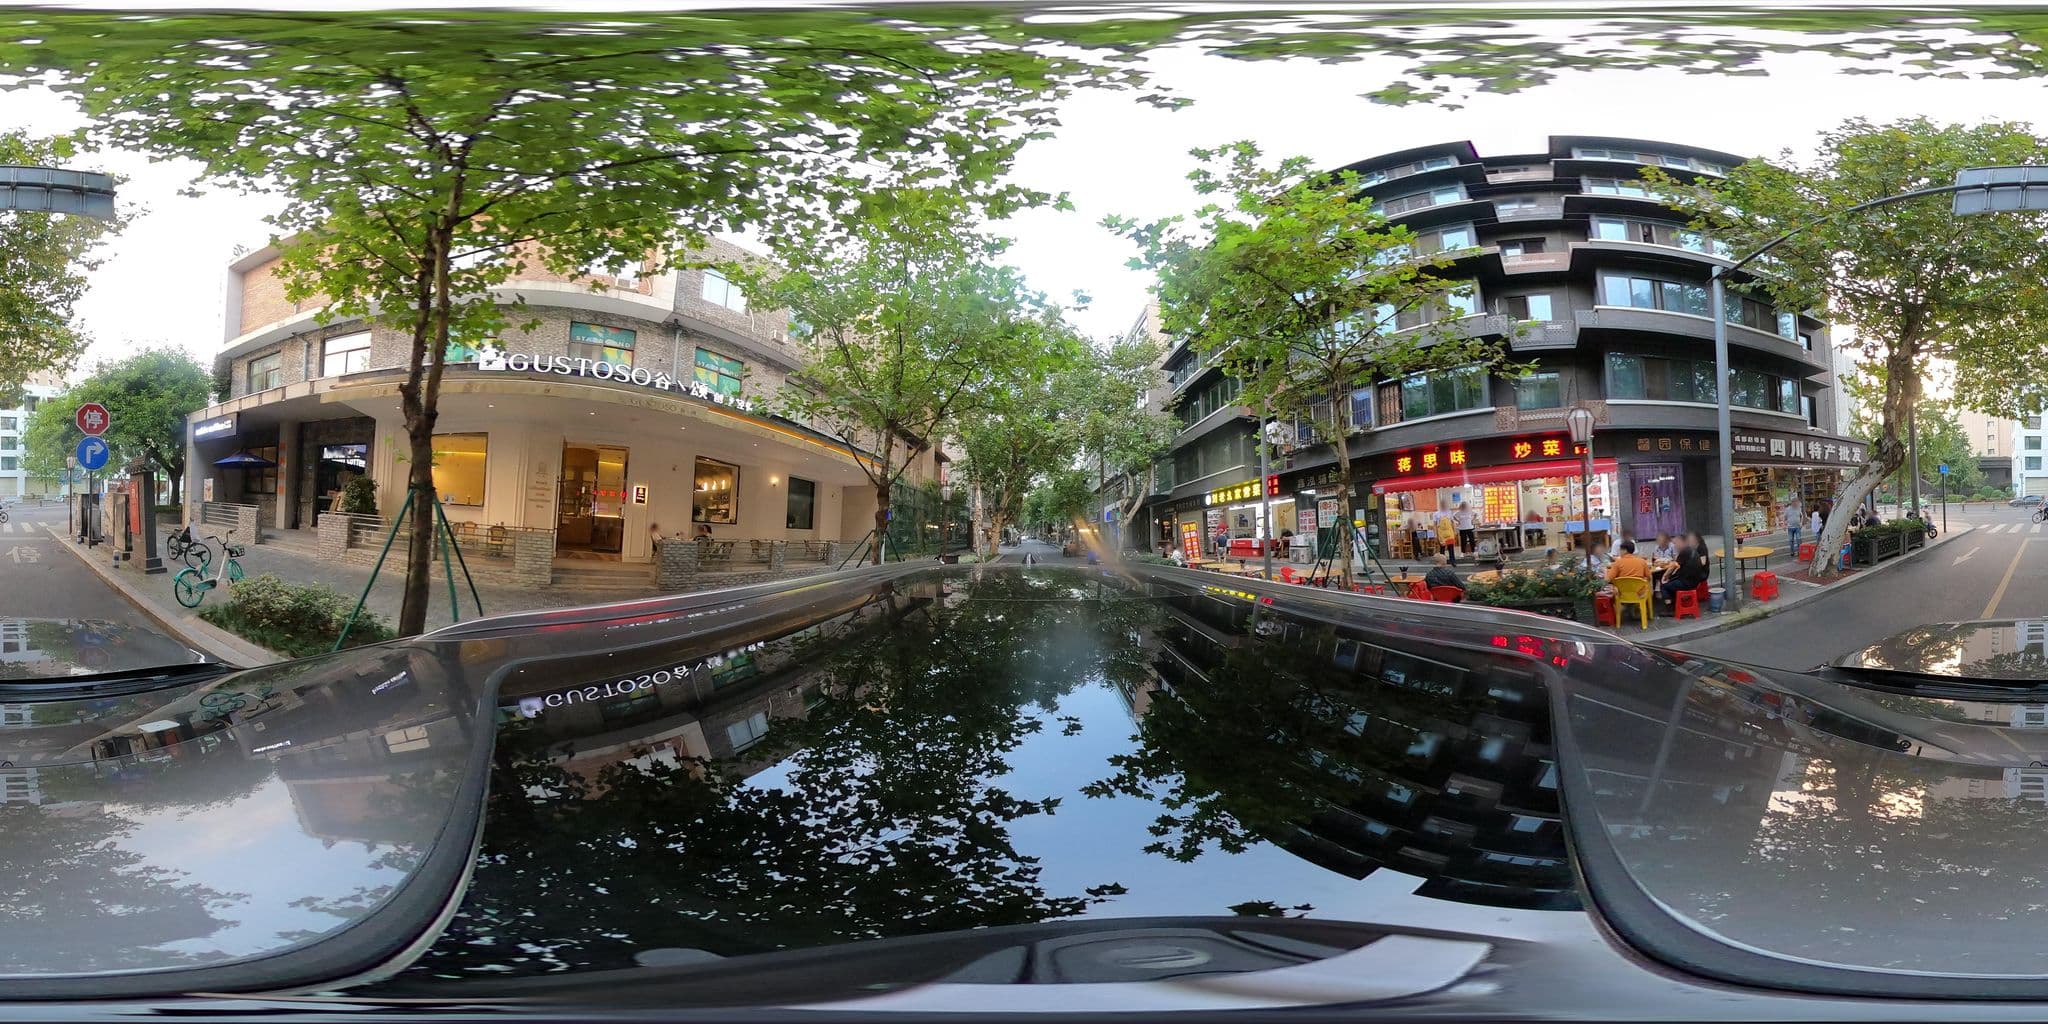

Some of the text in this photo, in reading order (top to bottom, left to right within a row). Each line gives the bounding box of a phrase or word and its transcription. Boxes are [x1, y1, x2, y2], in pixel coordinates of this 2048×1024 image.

[508, 353, 651, 386] GUSTOSO
[83, 409, 103, 429] 停
[1397, 450, 1466, 472] 蒋思味
[1514, 439, 1561, 459] 炒菜
[1770, 438, 1862, 463] 四川特产批发
